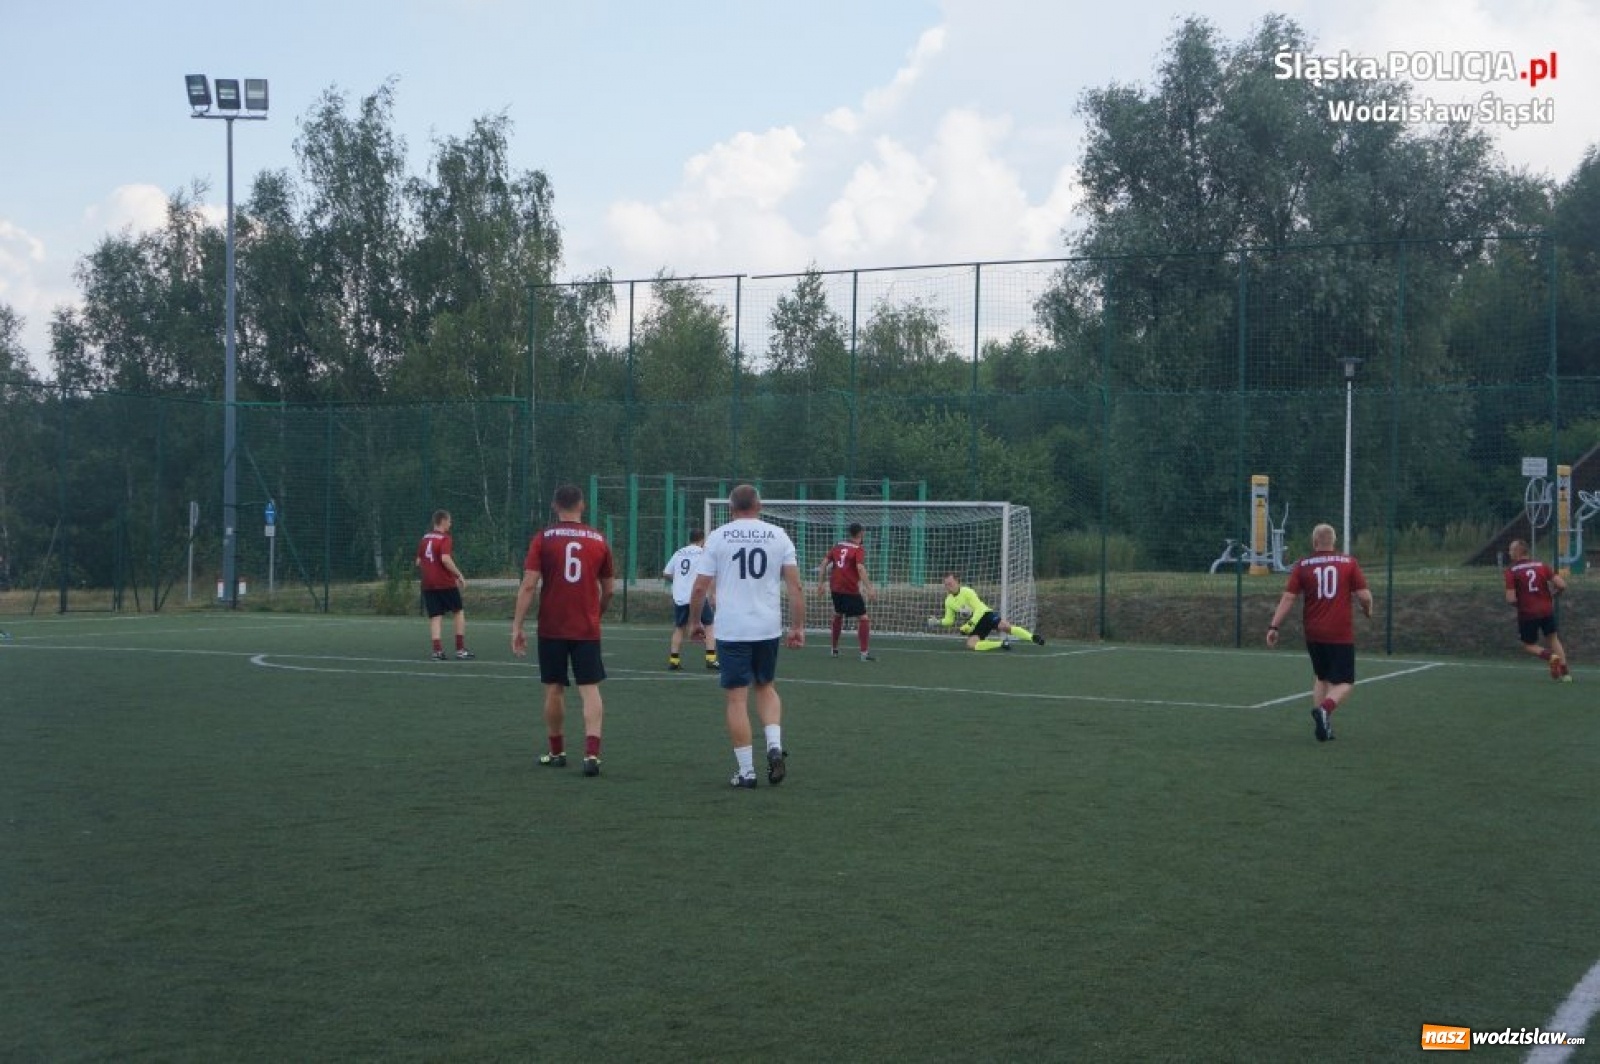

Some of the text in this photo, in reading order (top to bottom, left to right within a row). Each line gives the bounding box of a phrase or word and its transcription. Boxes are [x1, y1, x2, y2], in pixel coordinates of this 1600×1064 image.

[723, 529, 775, 539] POLICJA
[425, 540, 434, 562] 4
[565, 541, 582, 583] 6
[837, 548, 848, 568] 3
[680, 558, 691, 577] 9
[731, 547, 768, 580] 10
[1313, 565, 1338, 600] 10
[1525, 568, 1539, 593] 2
